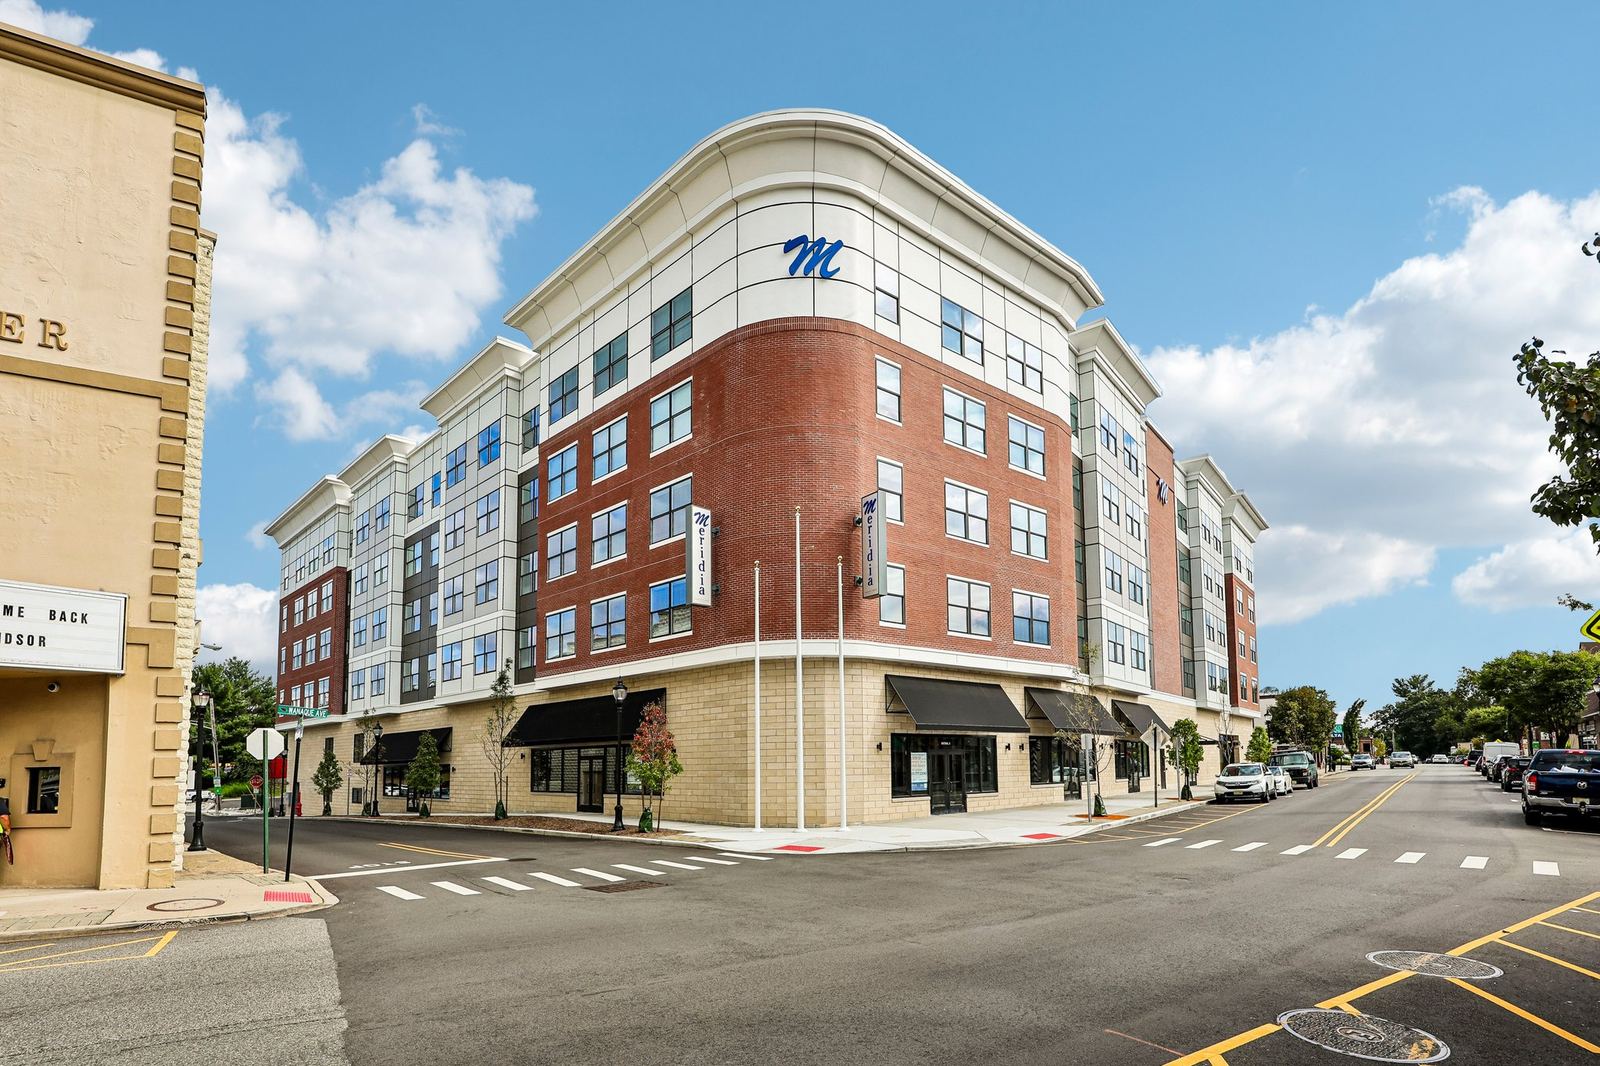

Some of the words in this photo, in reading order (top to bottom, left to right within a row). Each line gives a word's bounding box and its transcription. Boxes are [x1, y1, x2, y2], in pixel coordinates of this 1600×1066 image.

[0, 311, 69, 351] ER
[693, 511, 710, 596] Meridia
[863, 498, 877, 587] Meridia
[2, 604, 25, 618] ME
[48, 609, 88, 624] BACK
[0, 632, 46, 647] DSOR
[288, 707, 315, 717] WANAQUE
[315, 710, 327, 718] AVE
